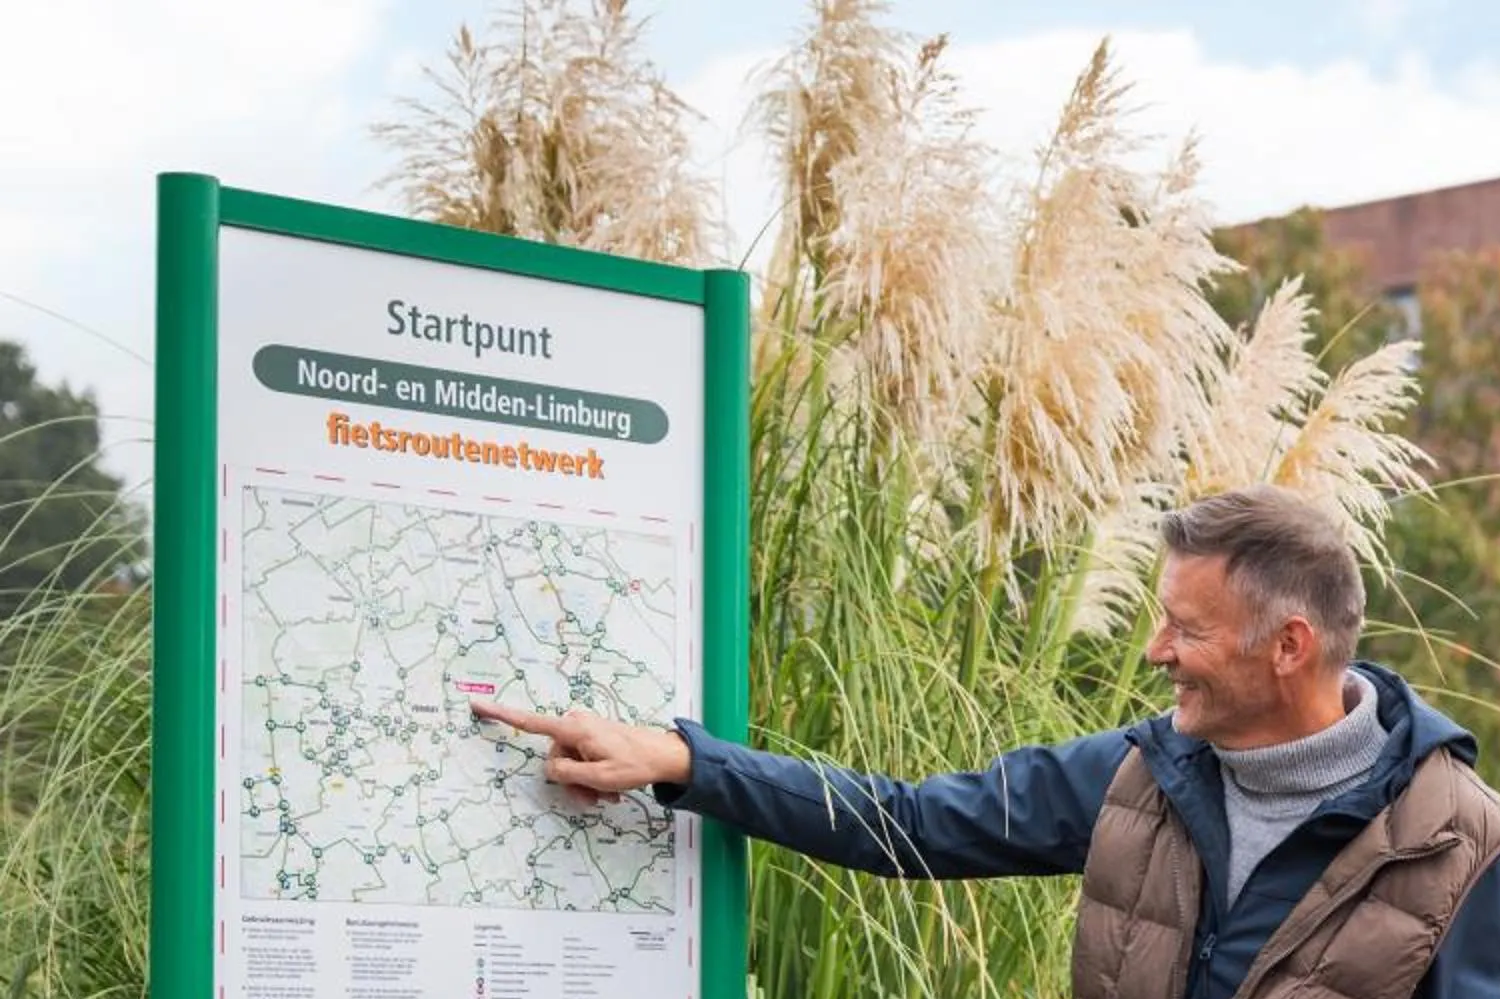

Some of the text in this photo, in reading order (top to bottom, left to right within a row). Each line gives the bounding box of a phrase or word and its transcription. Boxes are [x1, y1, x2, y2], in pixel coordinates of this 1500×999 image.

[387, 299, 553, 358] Startpunt
[298, 359, 632, 438] Noord- en Midden-Limburg
[326, 412, 605, 480] fietsroutenetwerk
